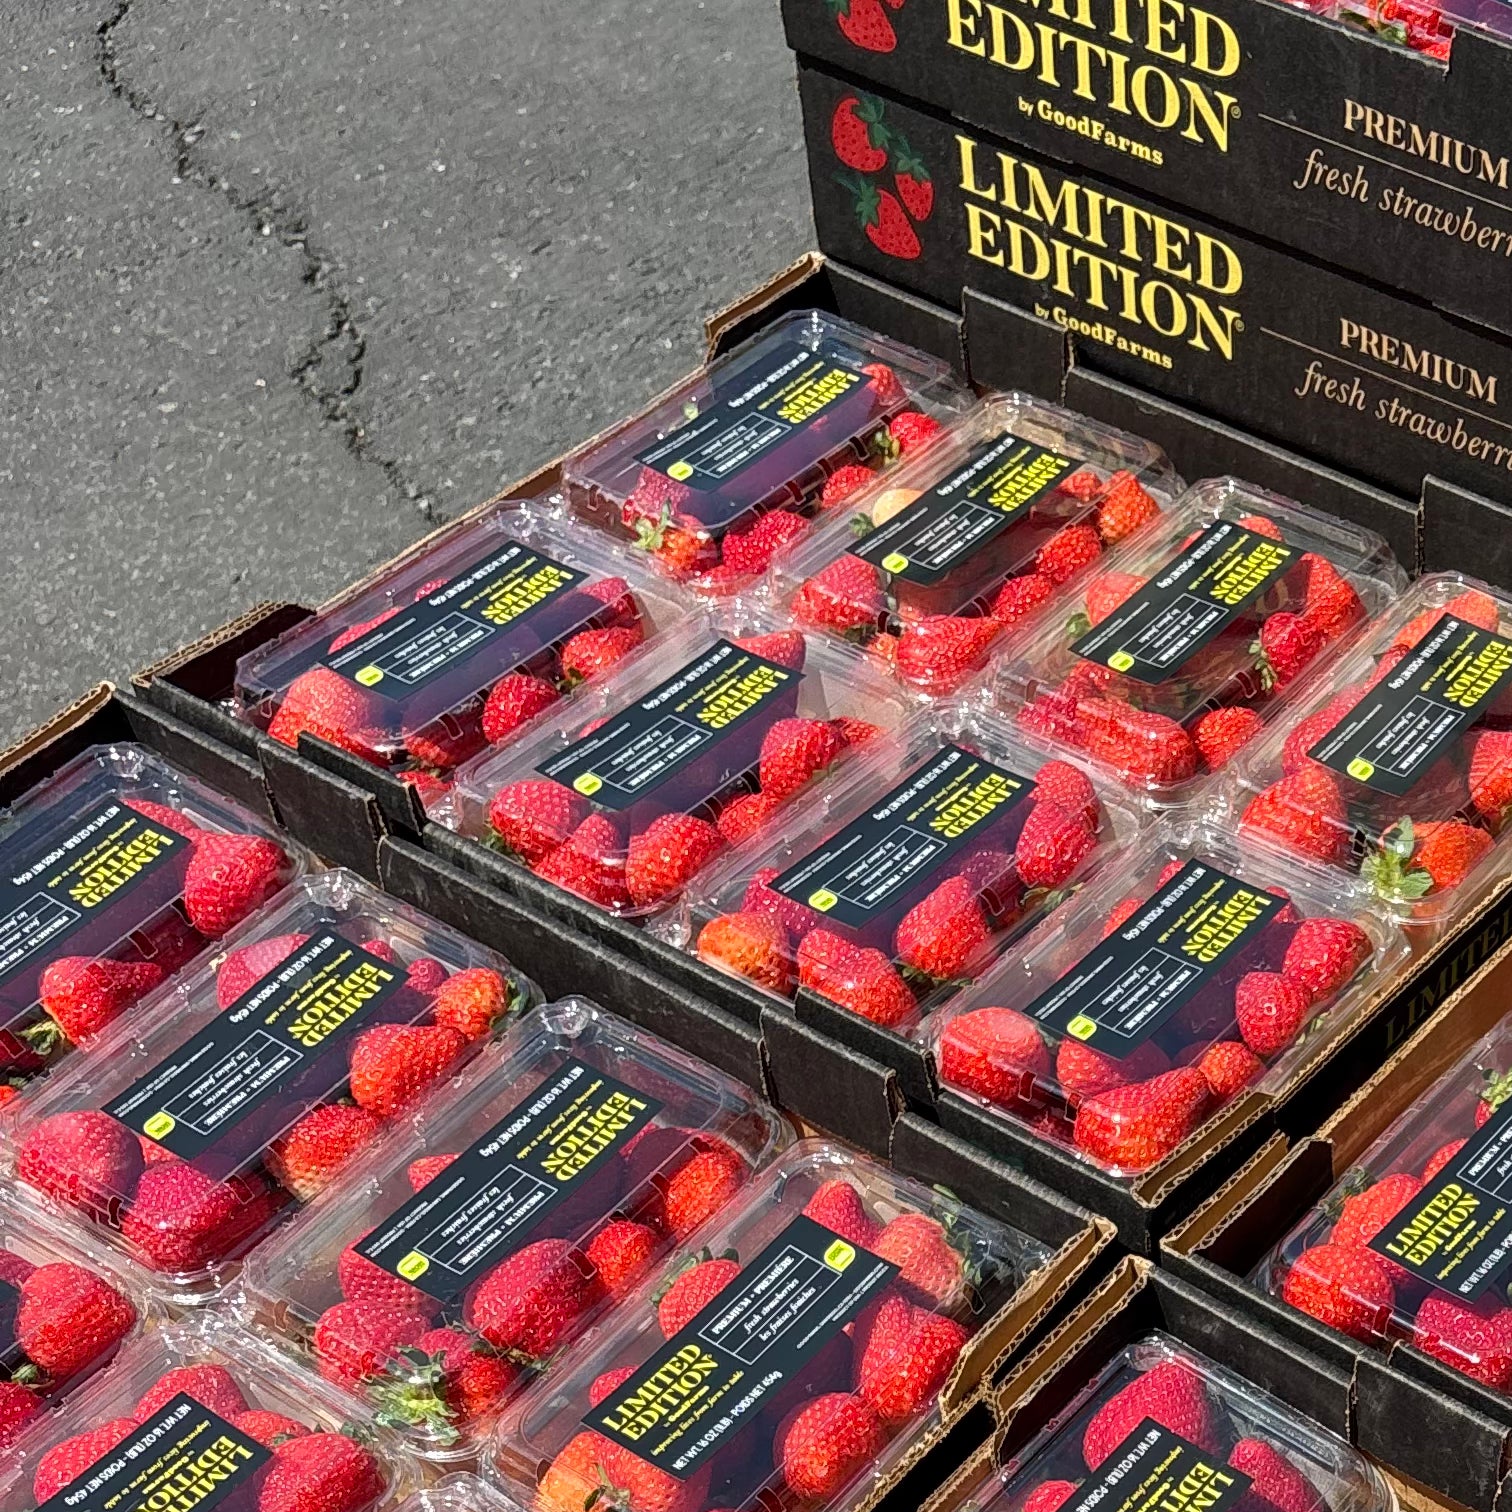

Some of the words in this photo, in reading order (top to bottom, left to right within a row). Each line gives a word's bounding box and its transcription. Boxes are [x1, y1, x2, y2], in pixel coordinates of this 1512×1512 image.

[1018, 96, 1035, 117] by
[1037, 99, 1164, 166] GoodFarms
[1343, 98, 1510, 189] PREMIUM
[1293, 148, 1370, 204] fresh
[956, 135, 1244, 297] LIMITED
[1034, 302, 1050, 321] by
[1052, 304, 1173, 371] GoodFarms
[1340, 317, 1498, 406] PREMIUM
[1293, 360, 1366, 411] fresh
[944, 779, 1021, 838] LIMITED
[81, 835, 175, 906] LIMITED
[1197, 896, 1273, 961] LIMITED
[301, 969, 394, 1045] LIMITED
[555, 1099, 649, 1180] LIMITED
[1386, 1184, 1462, 1258] LIMITED
[603, 1344, 700, 1433] LIMITED
